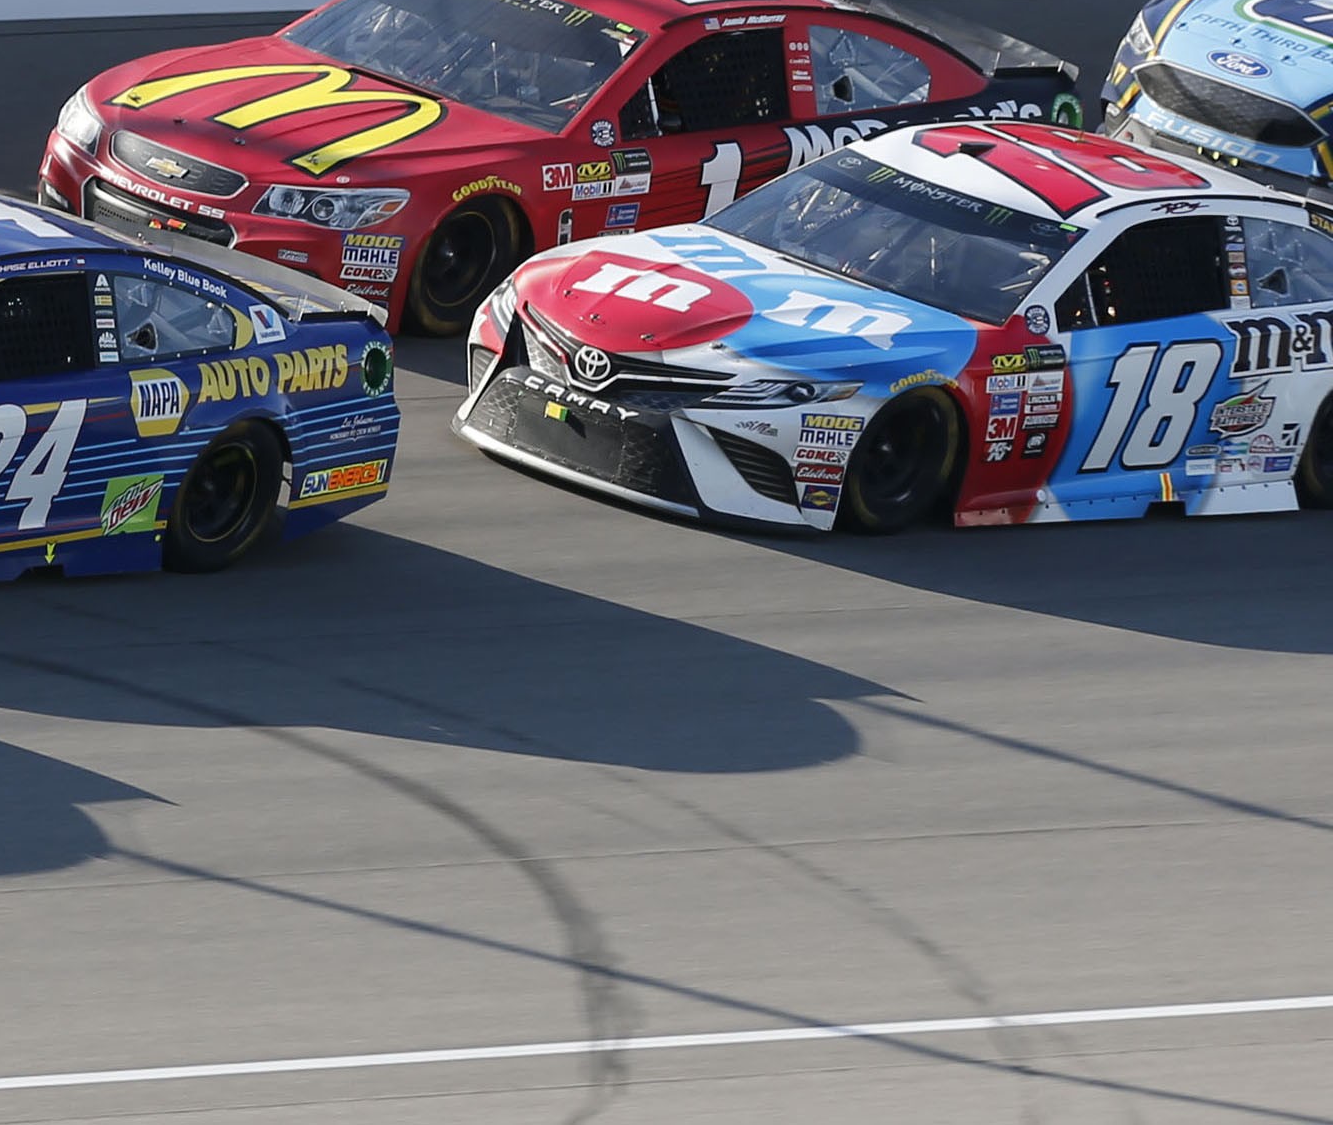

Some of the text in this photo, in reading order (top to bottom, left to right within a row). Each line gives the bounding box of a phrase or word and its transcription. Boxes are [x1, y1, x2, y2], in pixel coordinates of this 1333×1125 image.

[1191, 13, 1309, 53] FIFTH THIRD
[1215, 54, 1261, 75] Ford
[1147, 111, 1283, 165] FUSION
[452, 175, 523, 203] GOODYEAR
[545, 165, 572, 189] 3M
[700, 141, 744, 219] 1
[100, 168, 226, 219] CHEVROLET SS
[574, 183, 601, 196] Mobil
[893, 176, 983, 214] MONSTER
[344, 234, 404, 249] MOOG
[28, 259, 71, 270] ELLIOTT
[343, 247, 398, 264] MAHLE
[143, 258, 228, 299] Kelley Blue Book
[344, 267, 383, 279] COMP
[361, 341, 391, 368] AMERICAN
[198, 344, 349, 403] AUTO PARTS
[362, 373, 391, 397] ETHANOL
[890, 369, 960, 394] GOODYEAR
[988, 377, 1016, 389] Mobil
[138, 381, 180, 417] NAPA
[524, 376, 640, 421] CAMRY
[1027, 395, 1056, 404] LINCOLN
[1077, 340, 1224, 474] 18
[1214, 403, 1270, 415] INTERSTATE
[804, 415, 863, 430] MOOG
[988, 416, 1017, 439] 3M
[1214, 415, 1263, 427] BATTERIES
[799, 430, 854, 446] MAHLE
[796, 449, 836, 462] COMP
